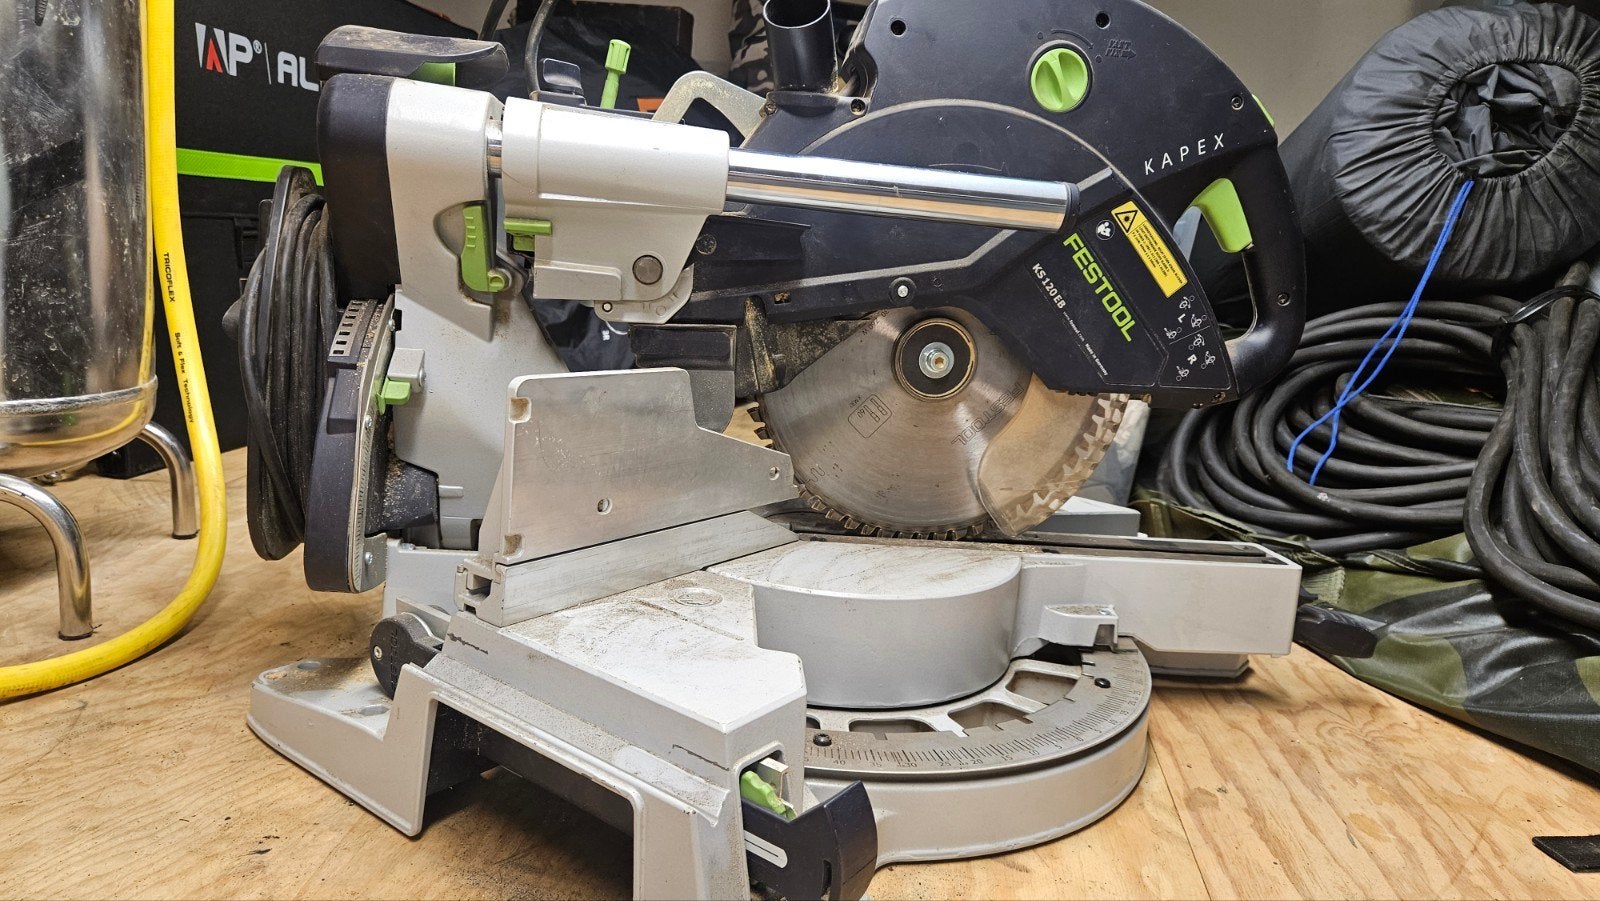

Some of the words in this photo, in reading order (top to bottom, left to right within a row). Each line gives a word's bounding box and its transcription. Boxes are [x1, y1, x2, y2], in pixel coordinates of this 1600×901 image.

[1144, 132, 1224, 176] KAPEX
[1032, 263, 1047, 279] KS
[1042, 277, 1058, 297] 120
[1053, 294, 1067, 309] EB
[1062, 232, 1136, 342] FESTOOL
[163, 252, 176, 303] TRICOFLEX
[183, 378, 194, 423] Technology
[1178, 313, 1186, 324] L
[1187, 354, 1198, 365] R
